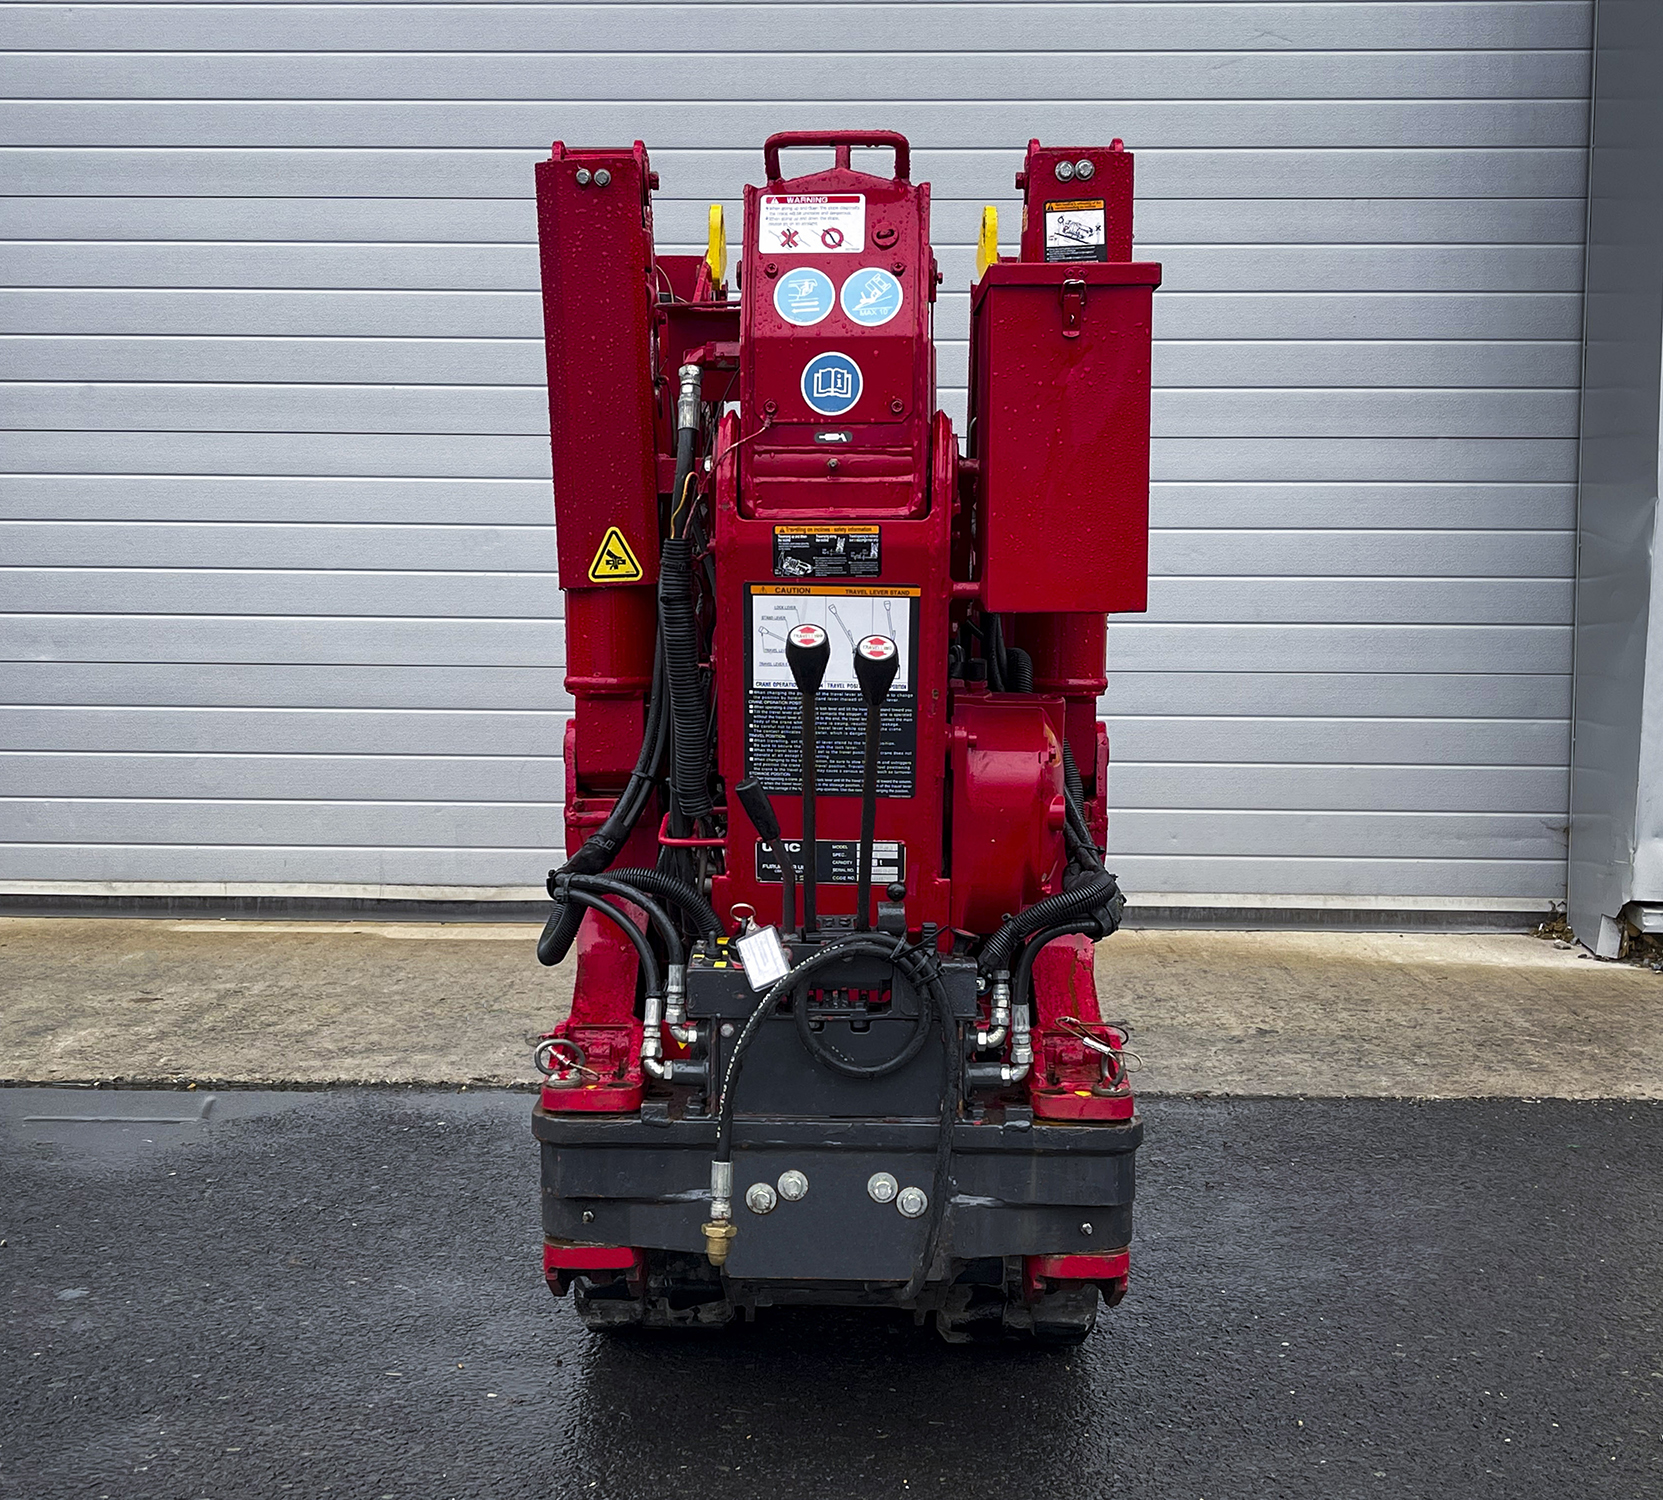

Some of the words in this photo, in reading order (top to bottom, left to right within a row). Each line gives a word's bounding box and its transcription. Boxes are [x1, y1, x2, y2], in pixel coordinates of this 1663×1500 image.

[786, 196, 828, 204] WARNING
[859, 308, 877, 316] MAX
[880, 308, 888, 316] 10
[762, 842, 801, 852] UIC
